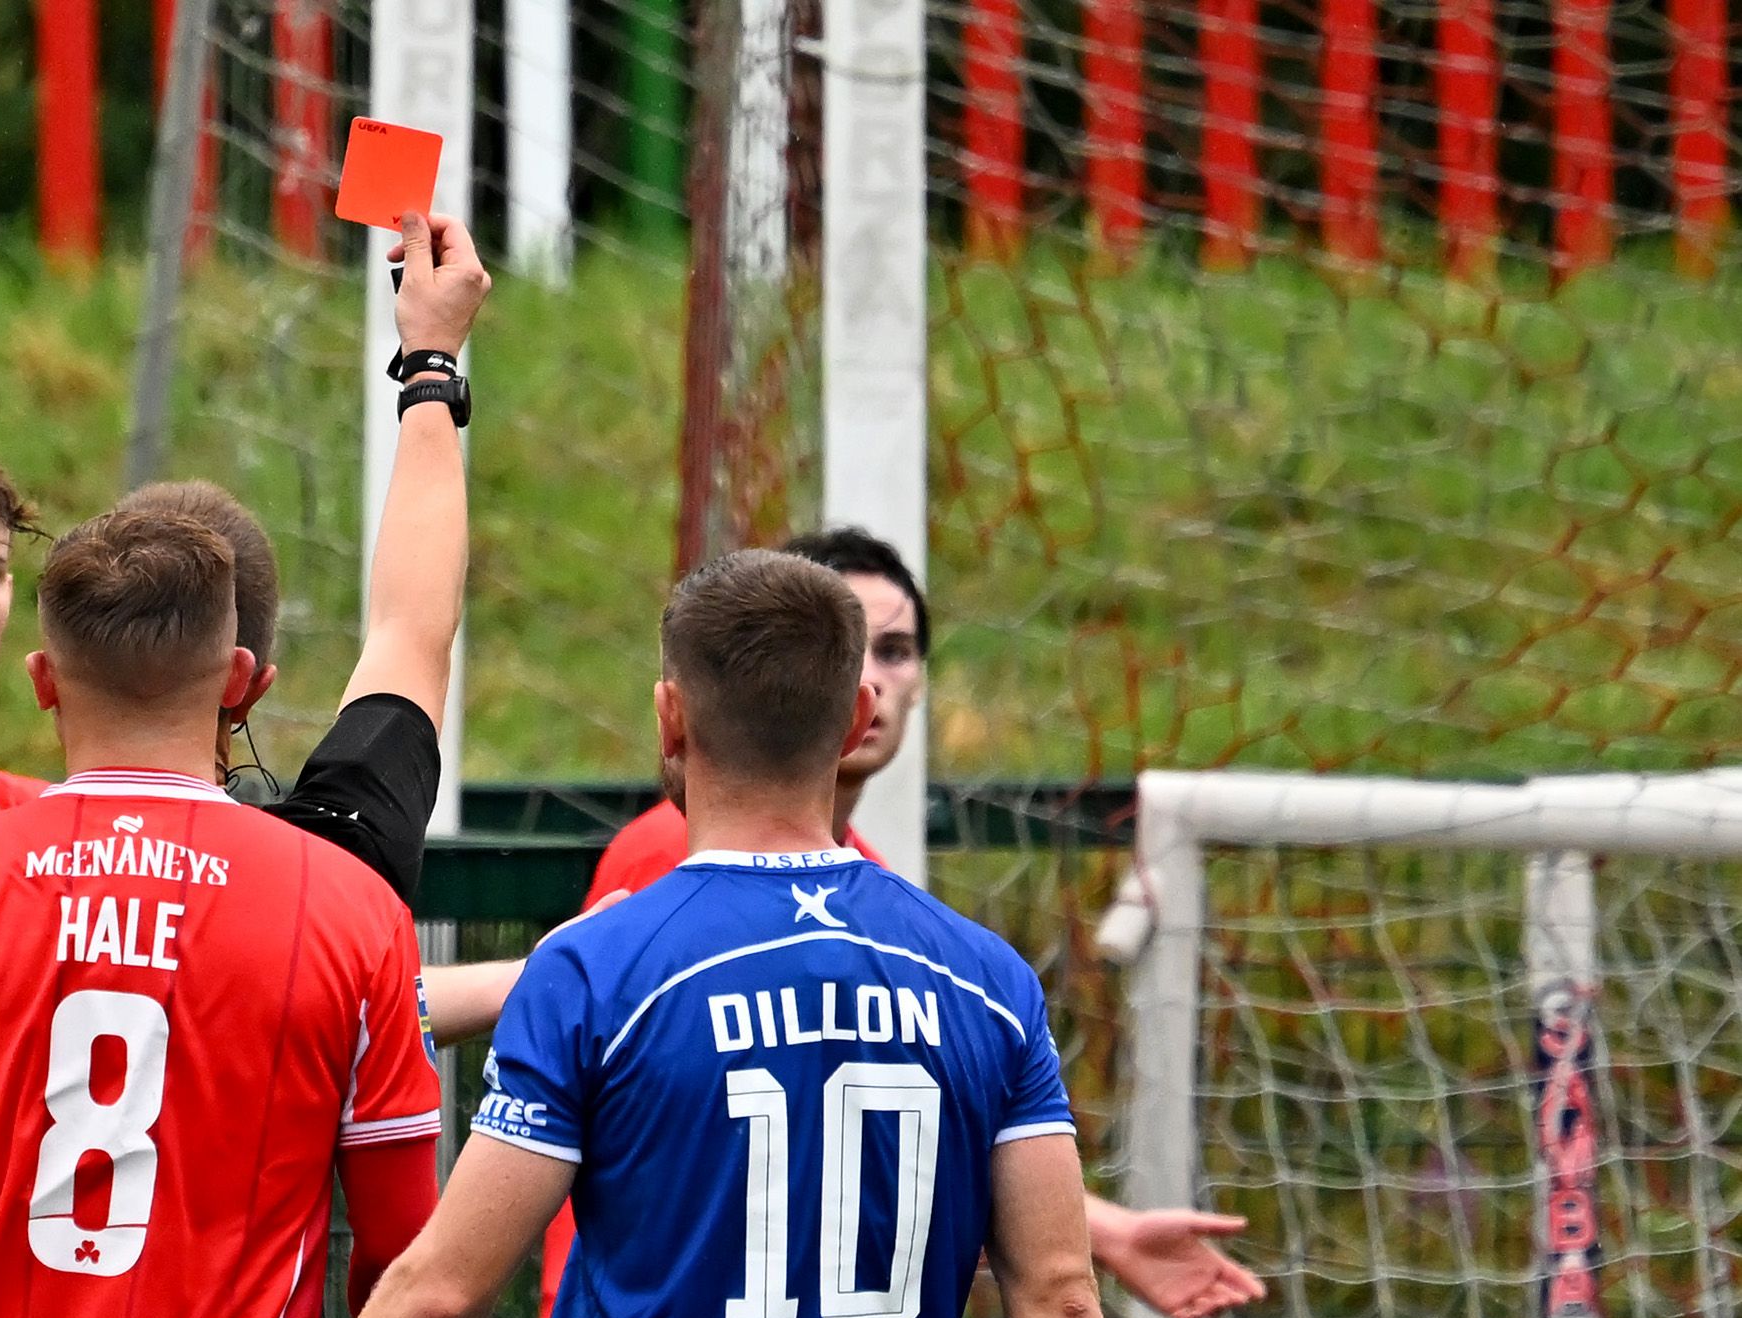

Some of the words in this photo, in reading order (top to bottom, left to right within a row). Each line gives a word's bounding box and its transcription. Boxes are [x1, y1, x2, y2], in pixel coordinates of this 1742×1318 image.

[56, 895, 186, 971] HALE
[708, 982, 941, 1053] DILLON
[28, 989, 169, 1277] 8
